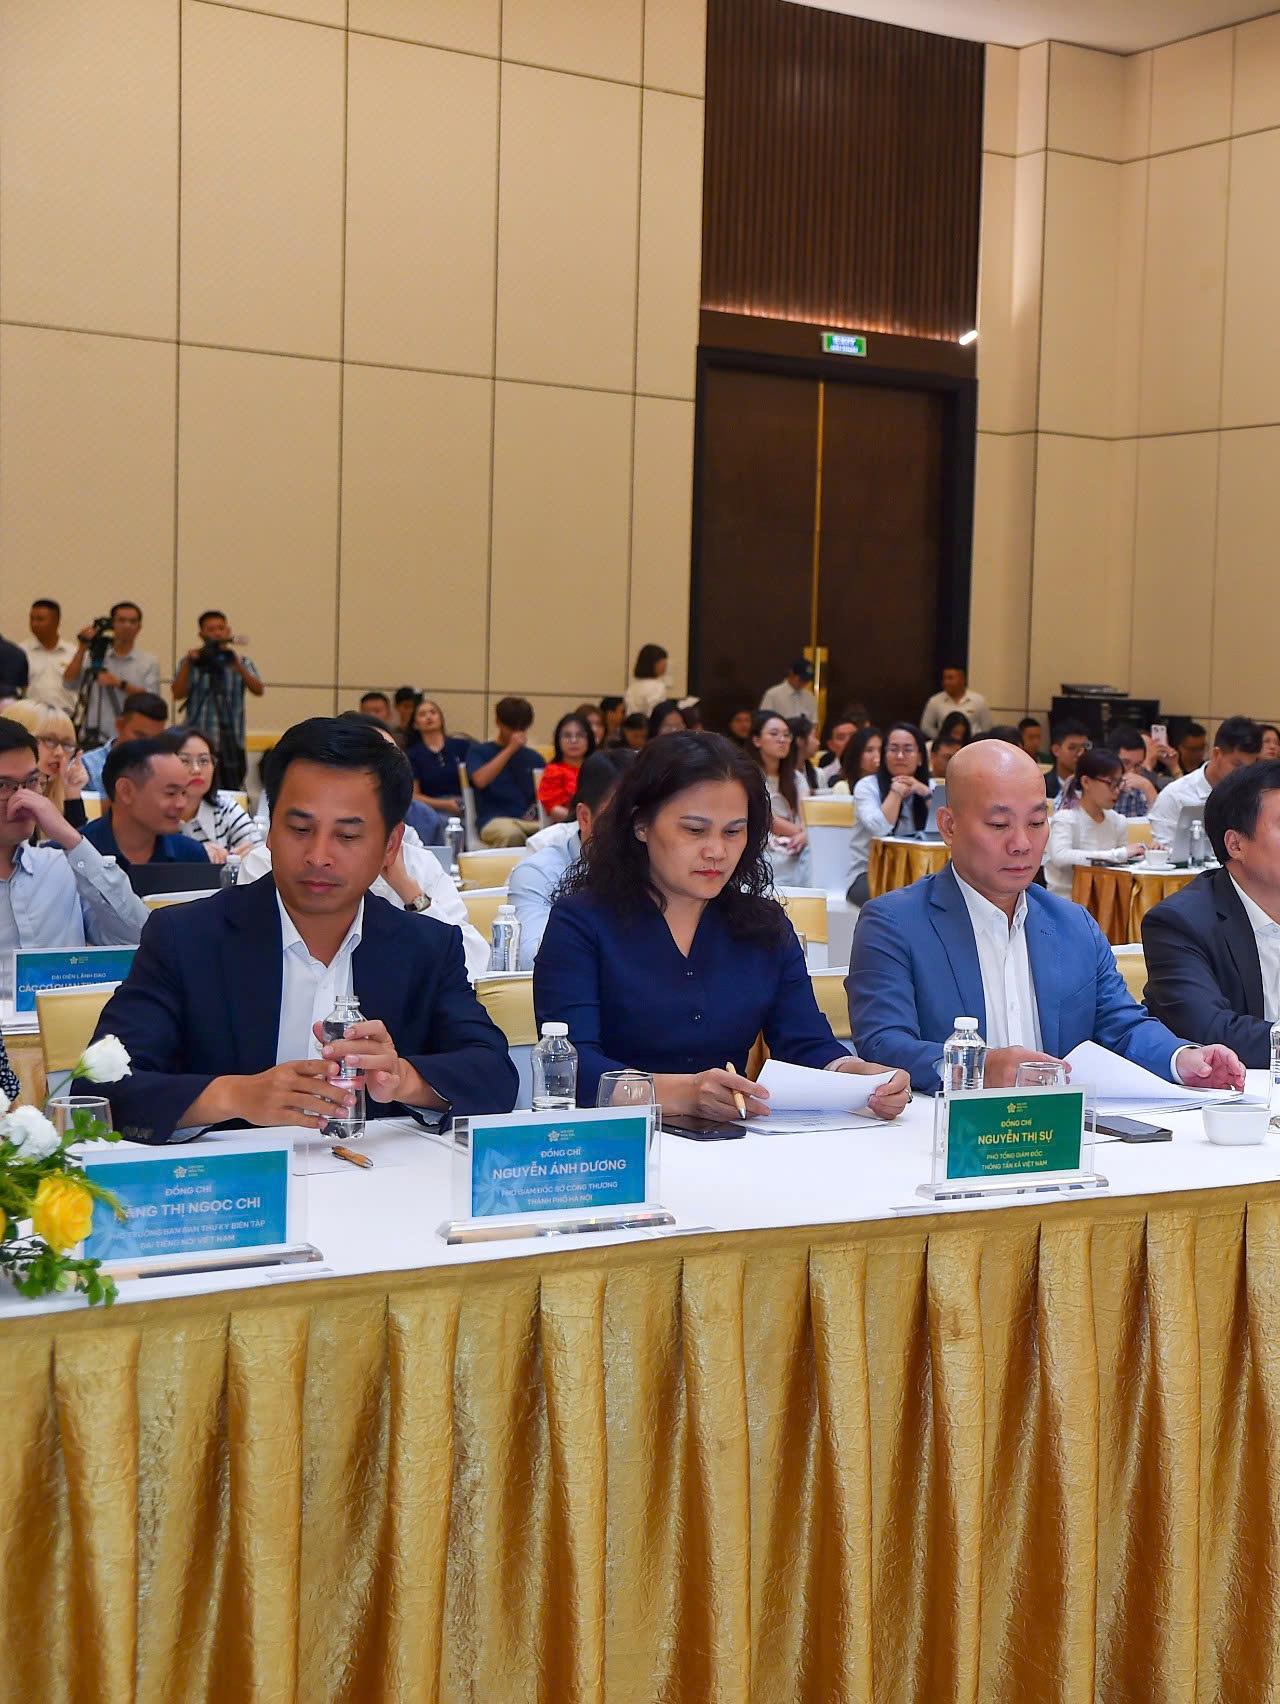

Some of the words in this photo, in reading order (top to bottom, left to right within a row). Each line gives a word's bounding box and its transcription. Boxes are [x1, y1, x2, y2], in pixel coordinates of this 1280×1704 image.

[978, 1129, 1020, 1145] NGUYỄN
[1022, 1131, 1038, 1144] THỊ
[1039, 1129, 1054, 1143] SỰ
[492, 1160, 547, 1180] NGUYỄN
[550, 1162, 577, 1176] ÁNH
[580, 1159, 627, 1173] DƯƠNG
[162, 1204, 185, 1218] THỊ
[188, 1200, 233, 1214] NGỌC
[236, 1197, 260, 1209] CHI
